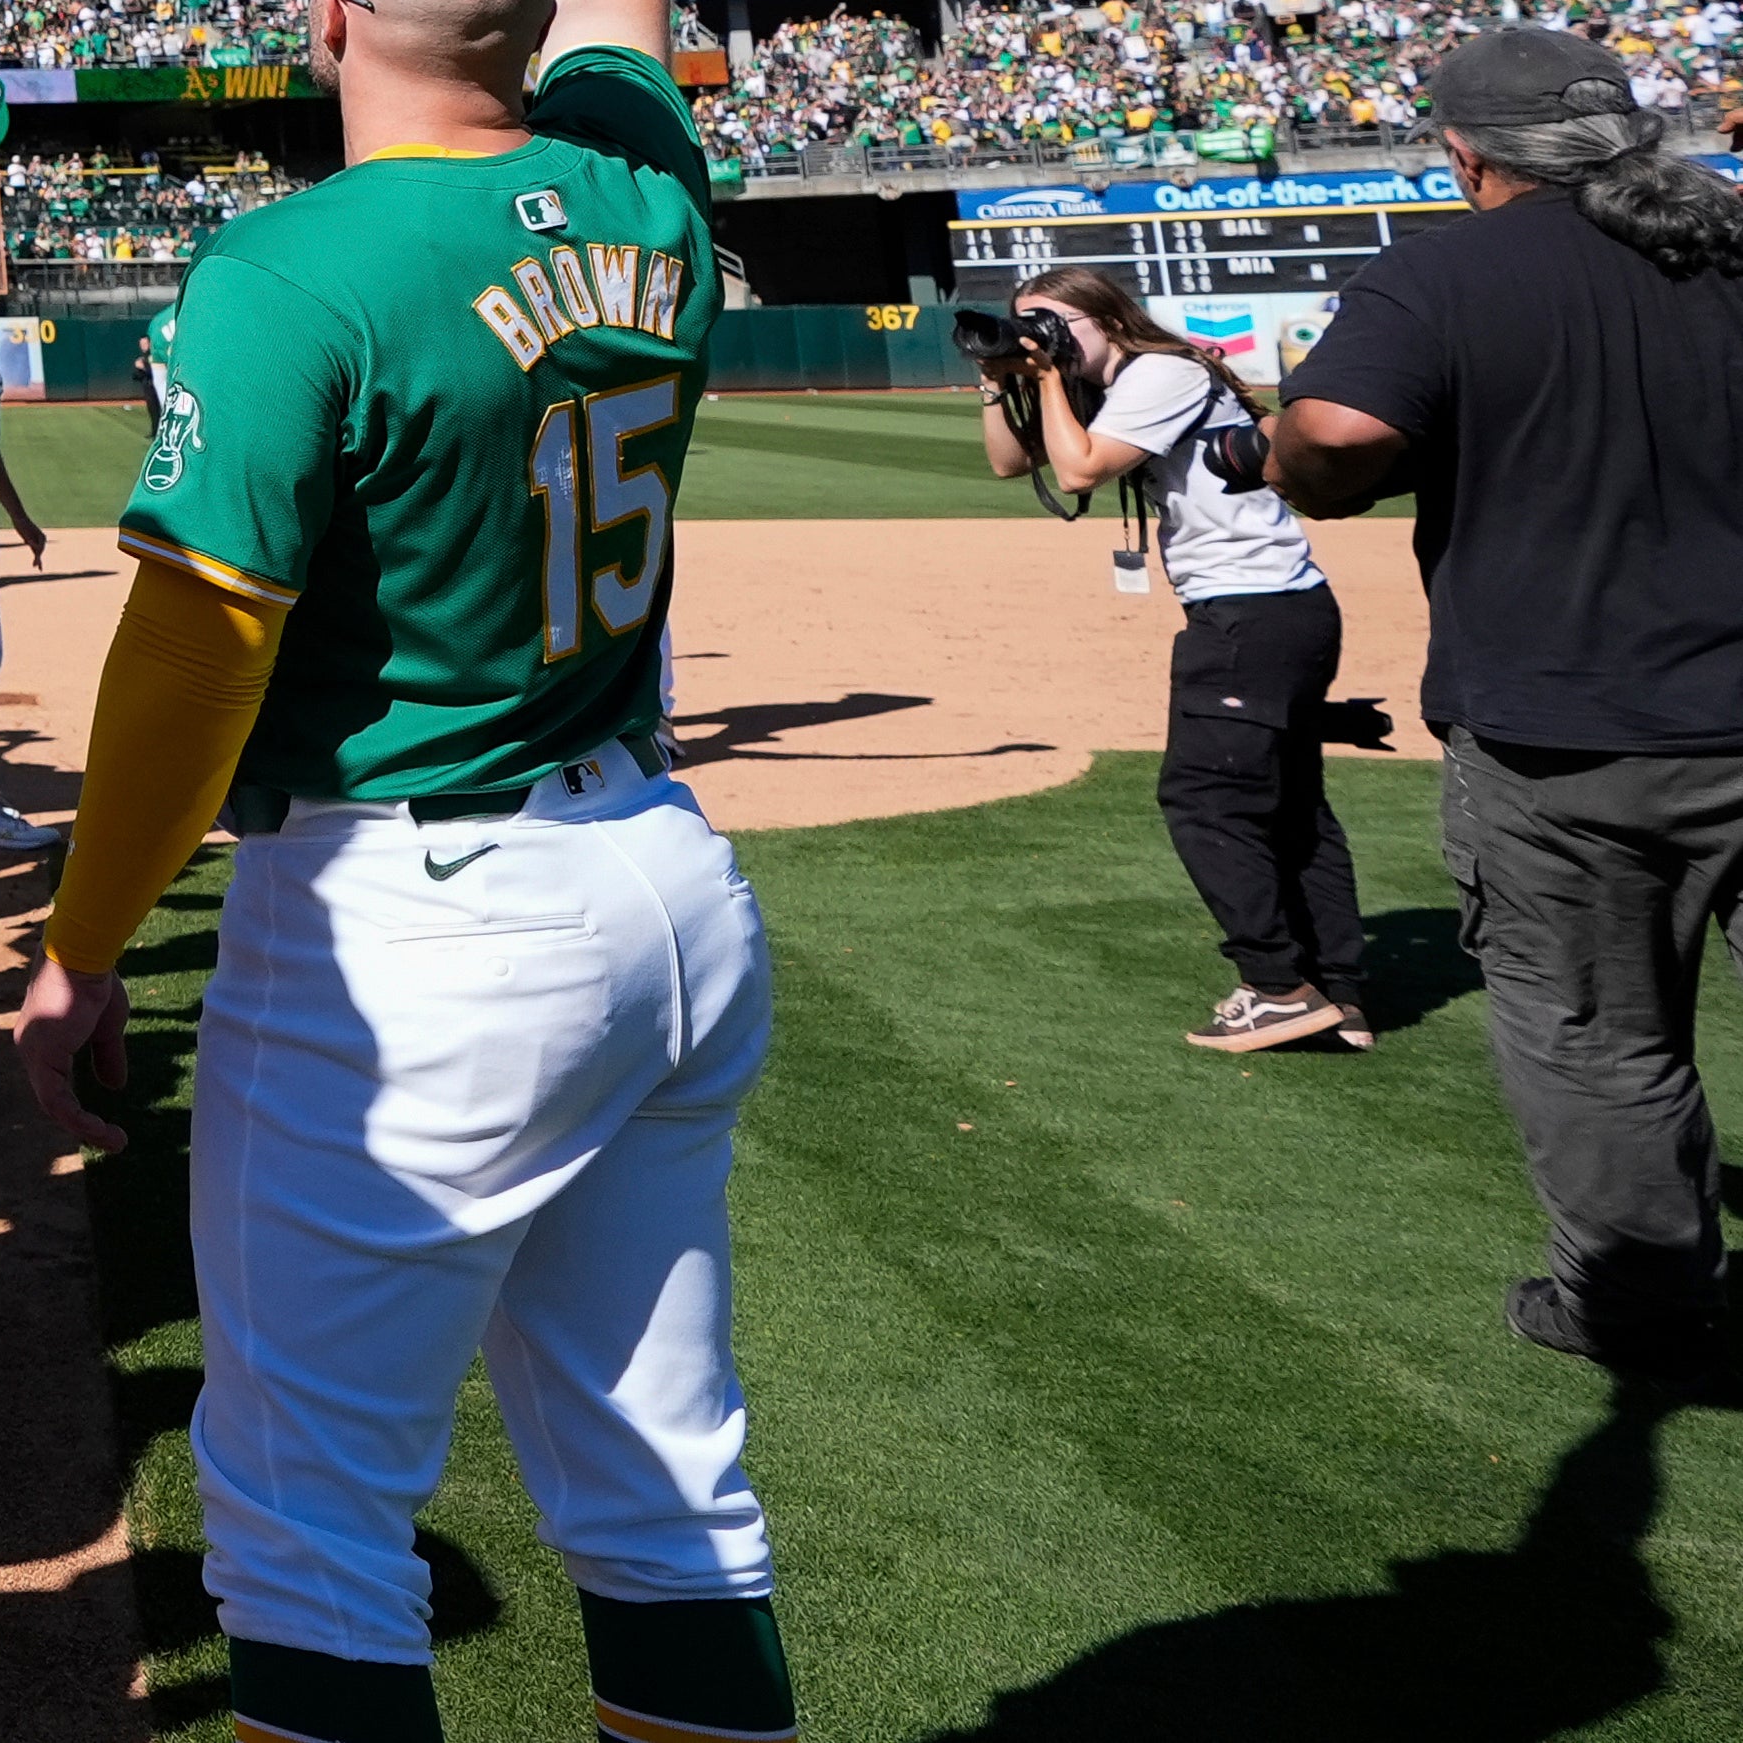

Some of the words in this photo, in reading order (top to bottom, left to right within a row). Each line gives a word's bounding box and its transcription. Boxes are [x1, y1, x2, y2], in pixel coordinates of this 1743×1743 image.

[180, 65, 219, 99] A's
[225, 65, 290, 98] WIN!
[1154, 174, 1422, 211] Out-of-the-park
[1221, 219, 1268, 237] BAL
[1227, 257, 1275, 275] MIA
[472, 243, 683, 373] BROWN
[866, 304, 920, 331] 367
[529, 372, 682, 665] 15
